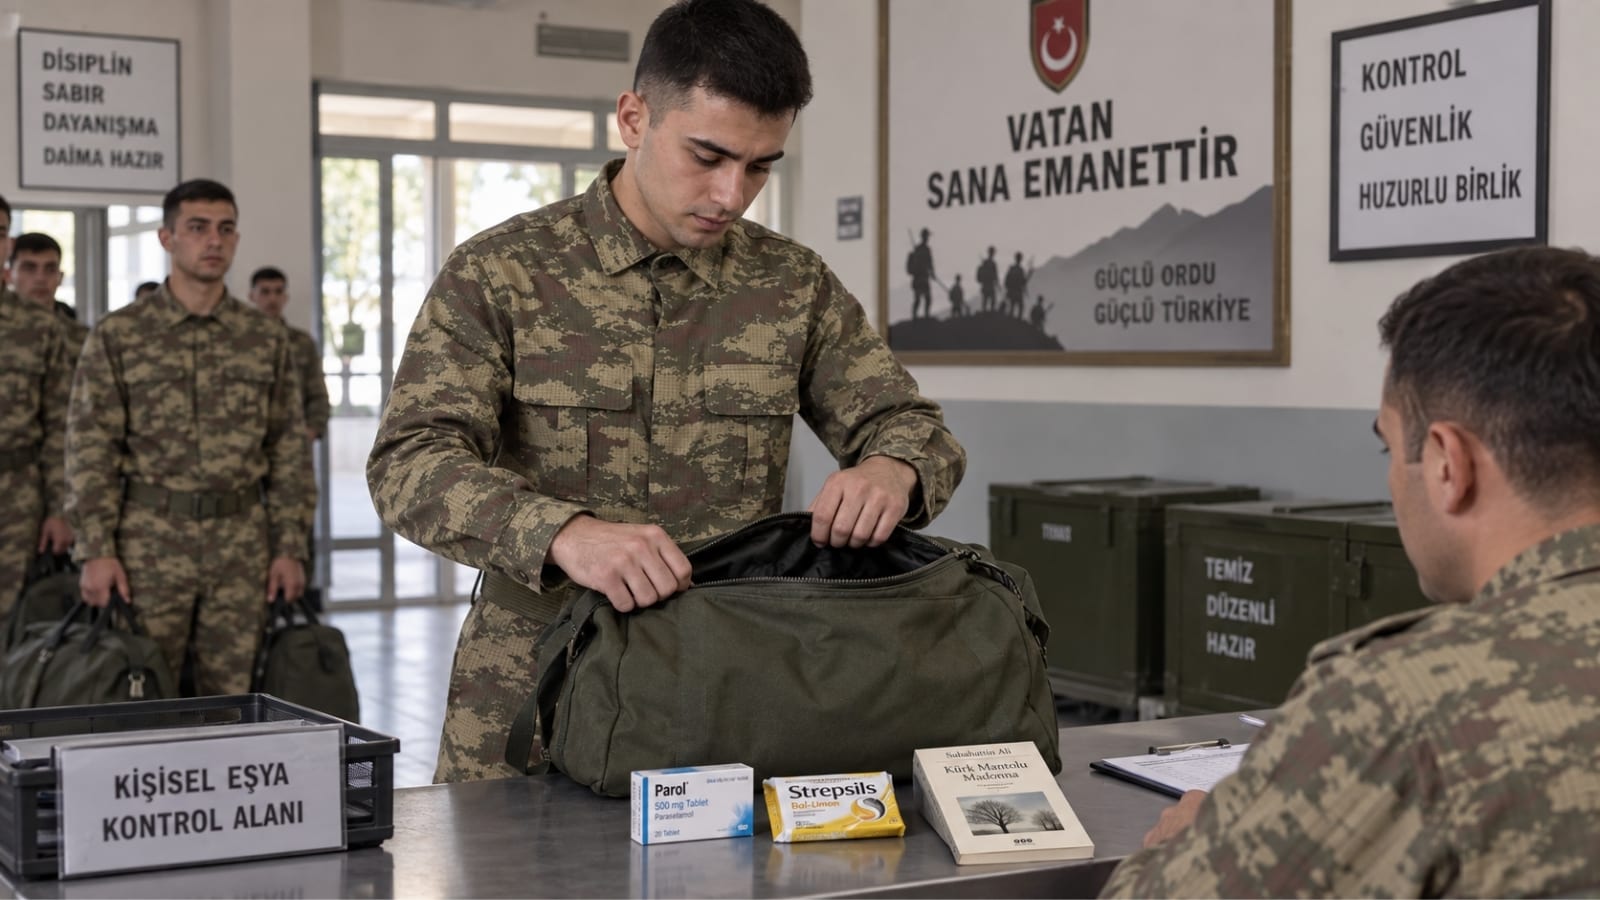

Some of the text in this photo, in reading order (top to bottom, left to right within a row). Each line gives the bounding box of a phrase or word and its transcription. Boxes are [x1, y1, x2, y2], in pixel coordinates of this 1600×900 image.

[1362, 48, 1467, 92] KONTROL
[42, 81, 105, 105] SABIR
[43, 112, 159, 138] DAYANIŞMA
[1007, 100, 1113, 153] VATAN
[1360, 104, 1472, 152] GÜVENLİK
[43, 144, 164, 170] DAİMA HAZIR
[927, 126, 1239, 210] SANA EMANETTİR
[1359, 163, 1522, 210] HUZURLU BİRLİK
[1094, 261, 1217, 295] GÜÇLÜ ORDU
[1094, 295, 1251, 329] GÜÇLÜ TÜRKİYE
[1205, 556, 1254, 585] TEMİZ
[1206, 594, 1275, 626] DÜZENLİ
[1206, 631, 1256, 662] HAZIR
[114, 762, 289, 803] KİŞİSEL EŞYA
[944, 760, 1029, 774] Kürk Mantolu
[655, 799, 709, 811] 500 mg Tablet
[788, 782, 877, 800] Strepsils
[102, 800, 303, 842] KONTROL ALANI
